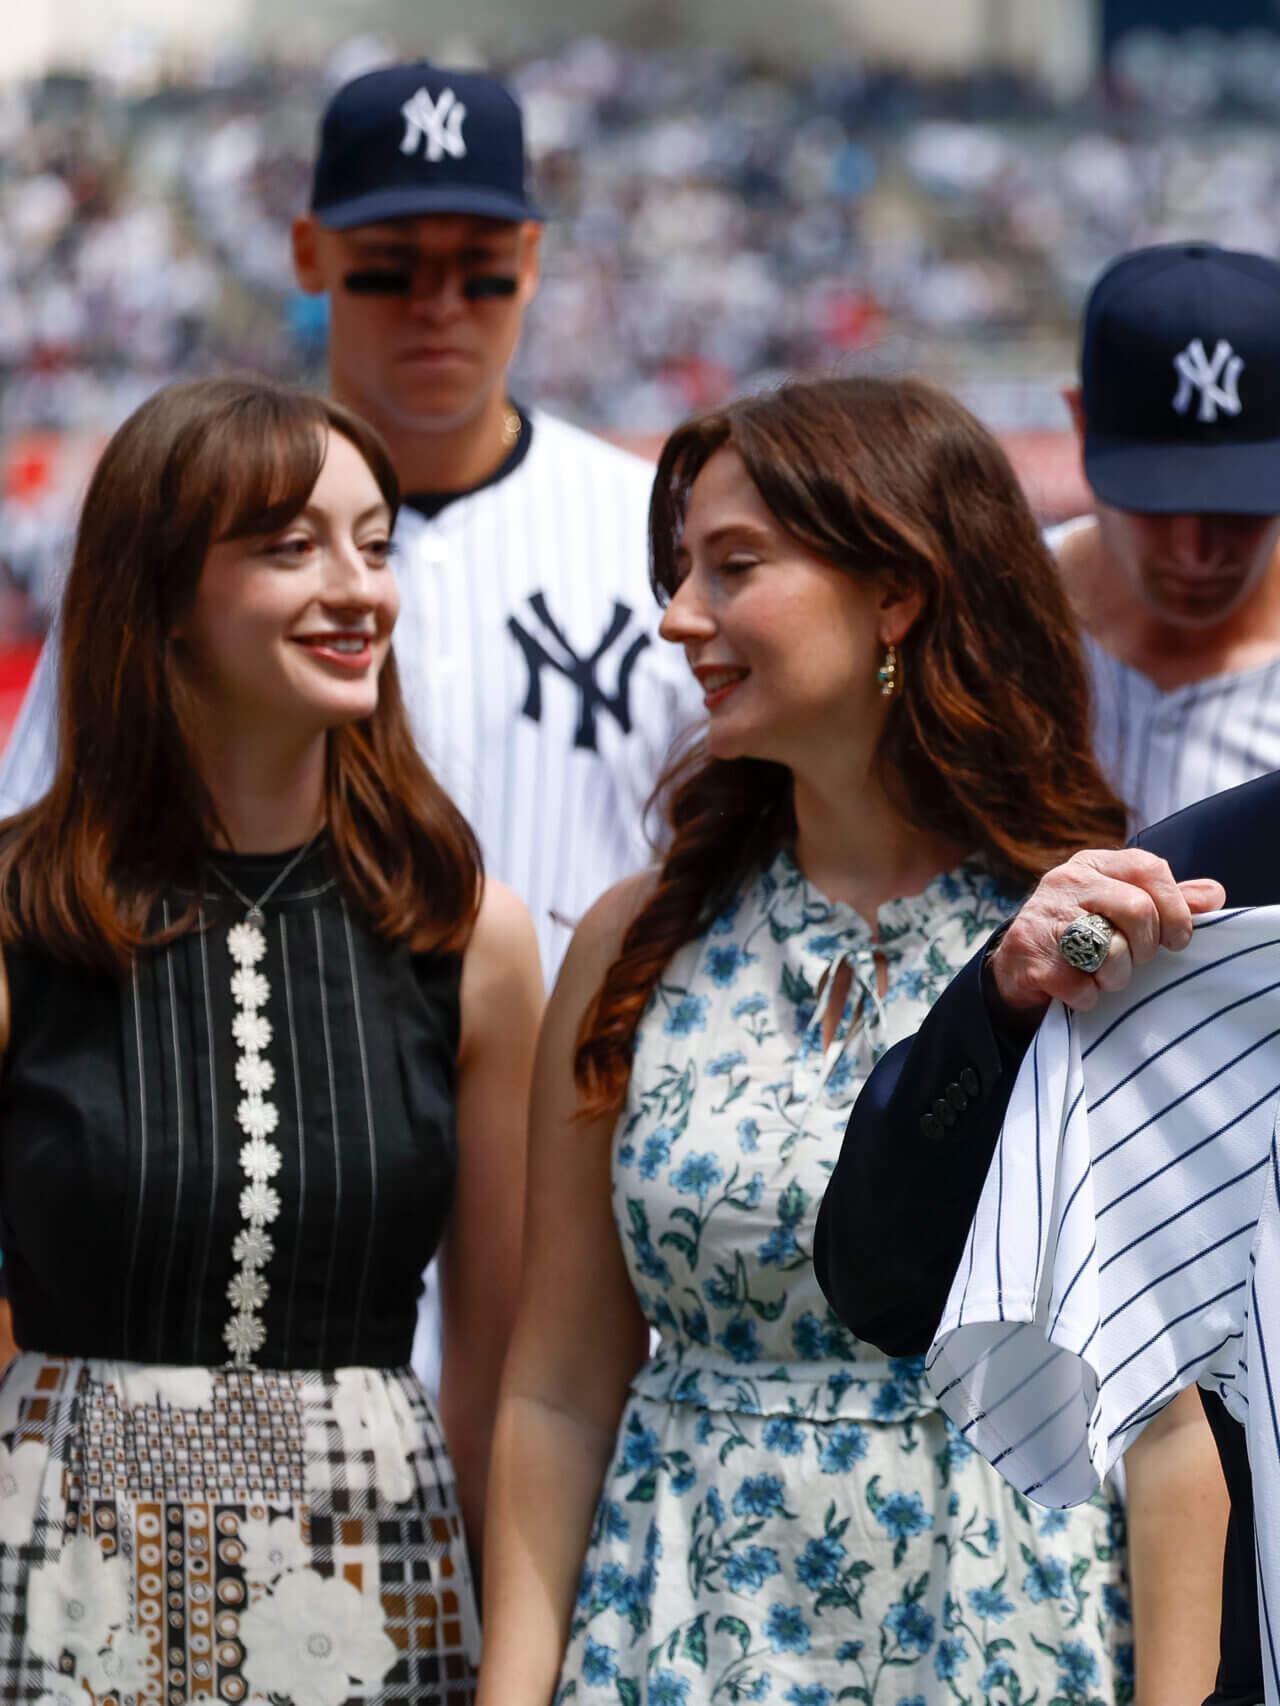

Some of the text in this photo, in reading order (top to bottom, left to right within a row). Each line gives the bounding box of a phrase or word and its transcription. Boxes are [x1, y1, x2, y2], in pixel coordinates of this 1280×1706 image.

[400, 86, 467, 162] NY
[1172, 338, 1244, 422] NY
[508, 592, 651, 752] NY
